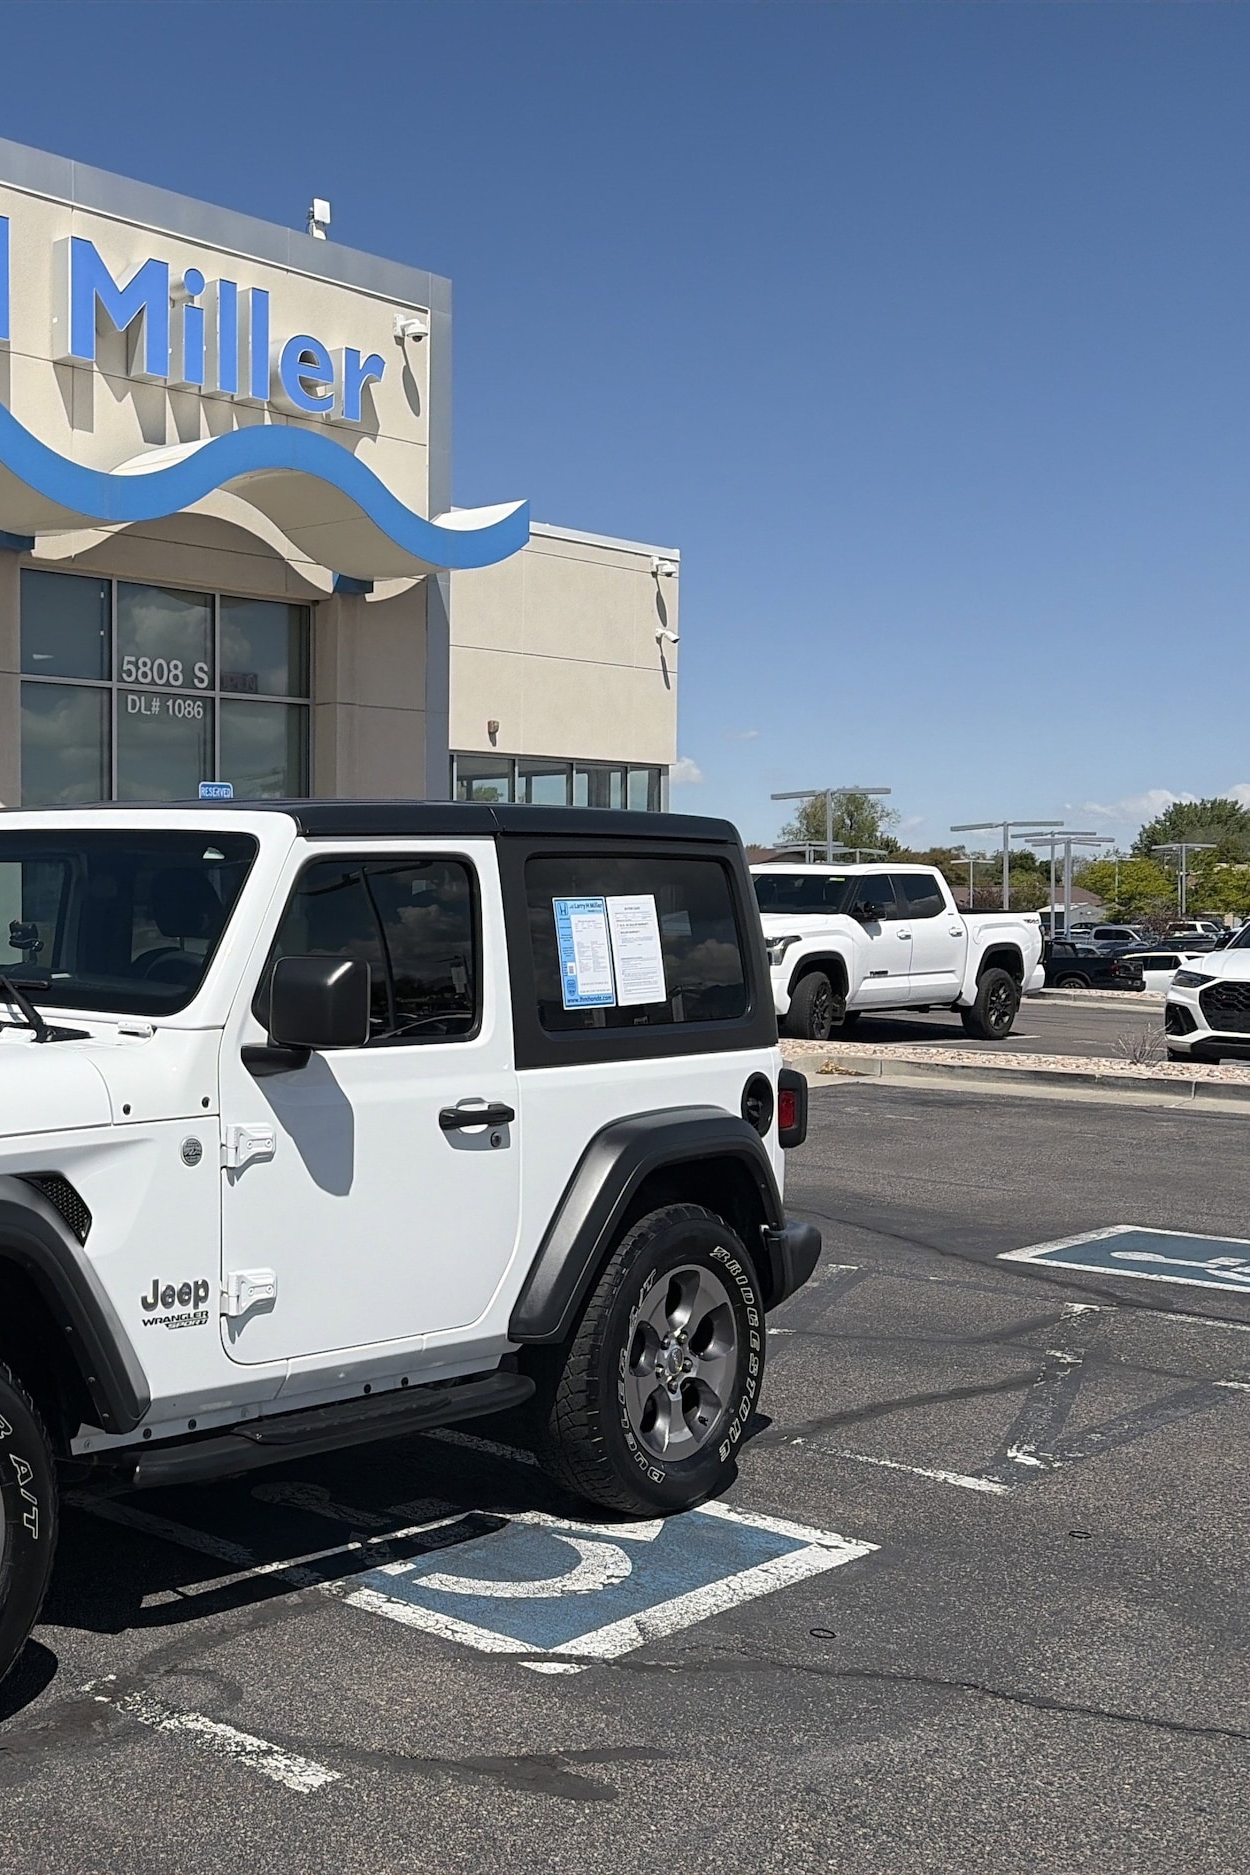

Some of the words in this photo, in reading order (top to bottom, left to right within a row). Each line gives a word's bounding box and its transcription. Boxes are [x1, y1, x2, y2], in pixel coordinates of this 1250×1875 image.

[54, 236, 386, 422] Miller
[121, 655, 184, 686] 5808
[193, 662, 209, 688] S
[127, 695, 161, 715] DL#
[166, 698, 204, 719] 1086
[201, 787, 230, 797] RESERVED
[141, 1278, 209, 1312] Jeep
[142, 1310, 209, 1327] WRANGLER
[168, 1319, 207, 1329] SPORT
[709, 1245, 760, 1463] BRIDGESTONE
[9, 1452, 41, 1540] A/T
